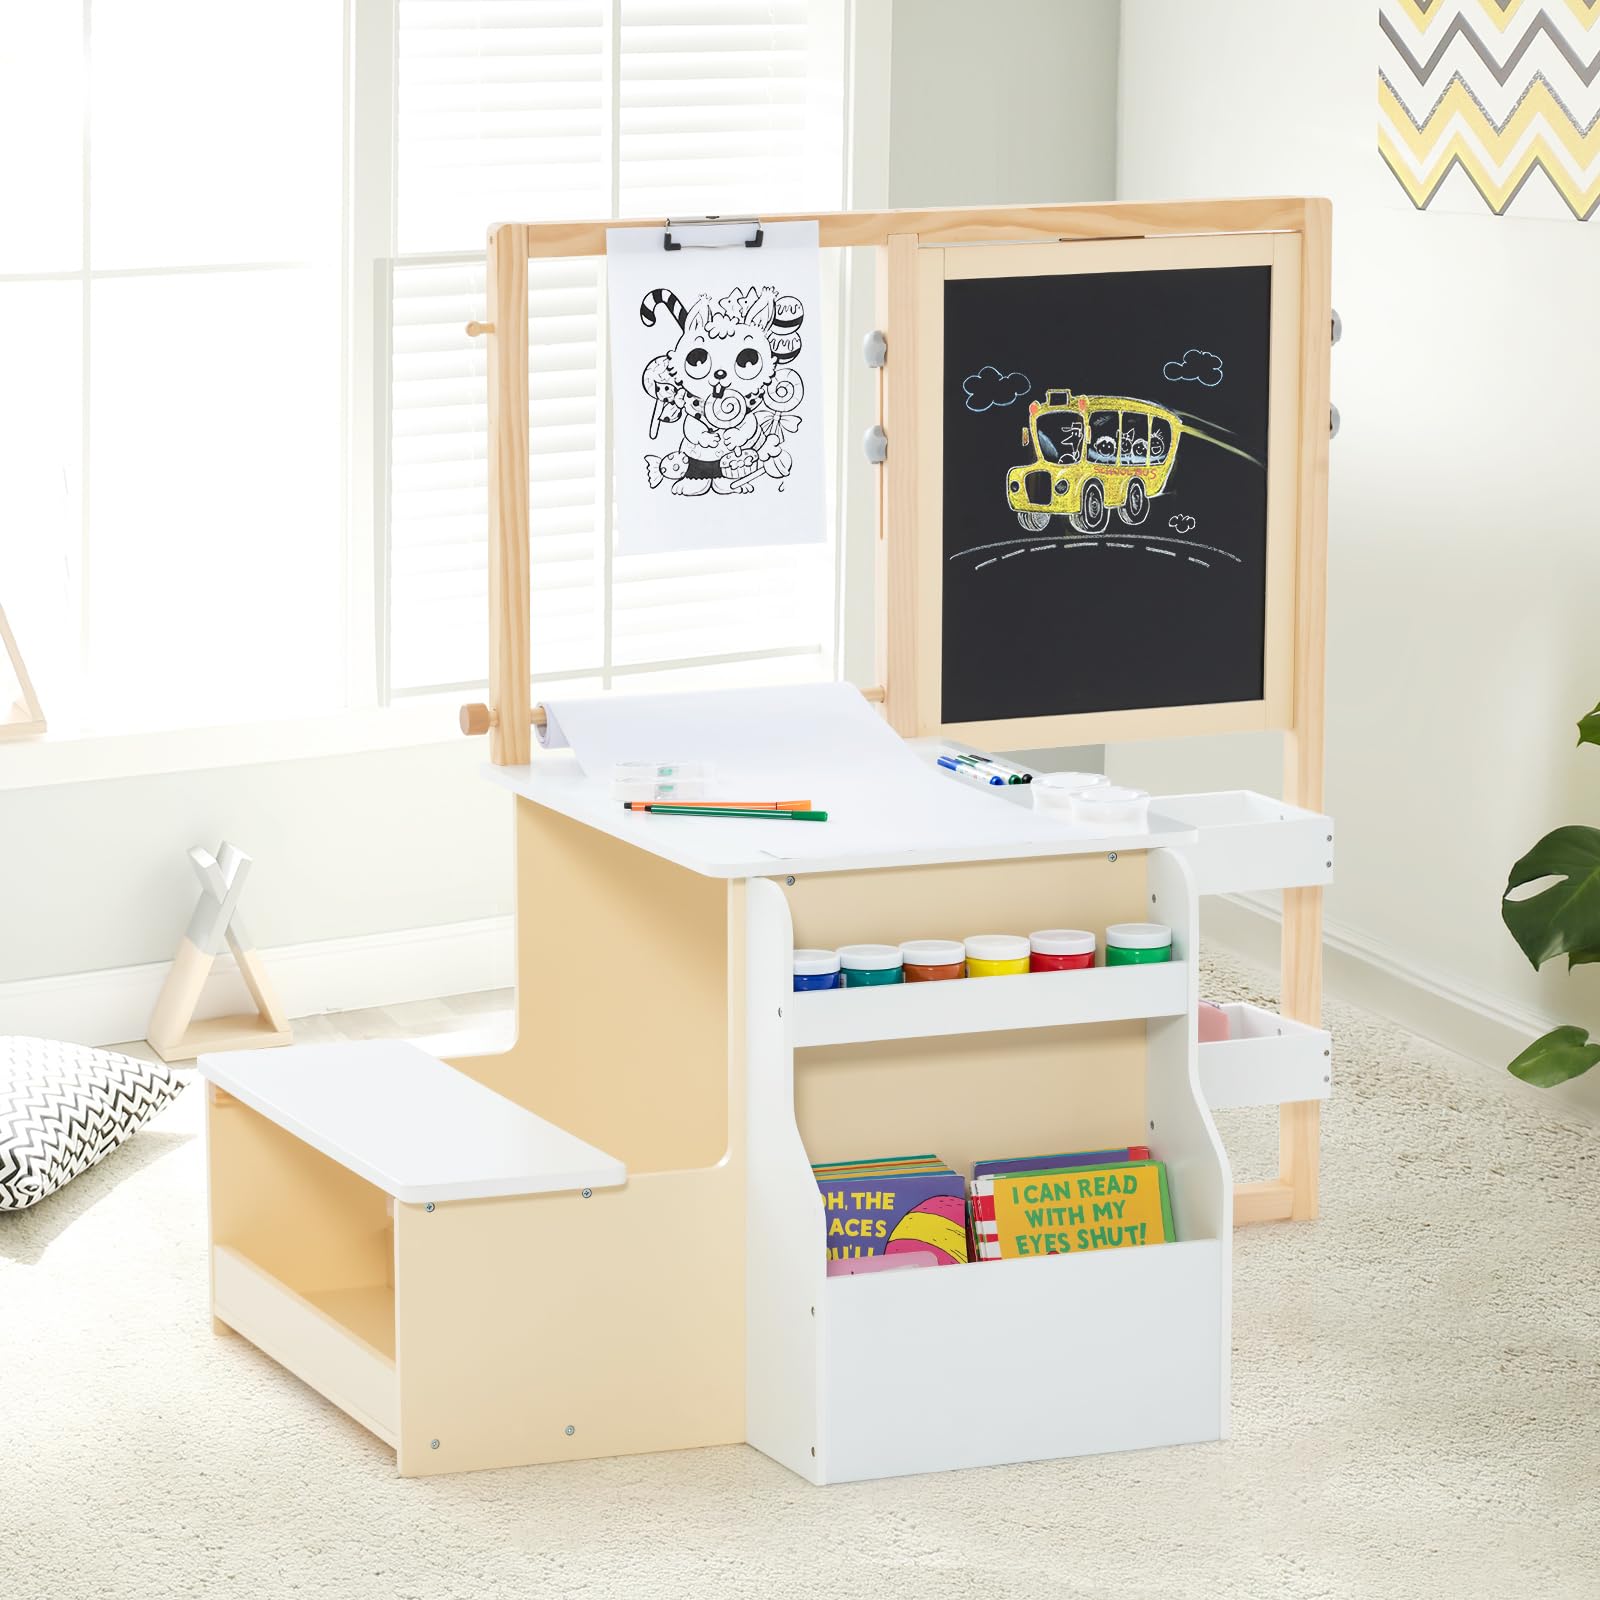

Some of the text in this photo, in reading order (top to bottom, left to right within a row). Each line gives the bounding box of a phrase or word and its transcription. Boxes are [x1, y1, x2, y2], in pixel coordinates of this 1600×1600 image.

[851, 1191, 895, 1210] THE
[1012, 1174, 1138, 1205] I CAN READ
[828, 1218, 887, 1238] ACES
[1024, 1200, 1126, 1228] WITH MY
[1015, 1222, 1147, 1255] EYES SHUT!
